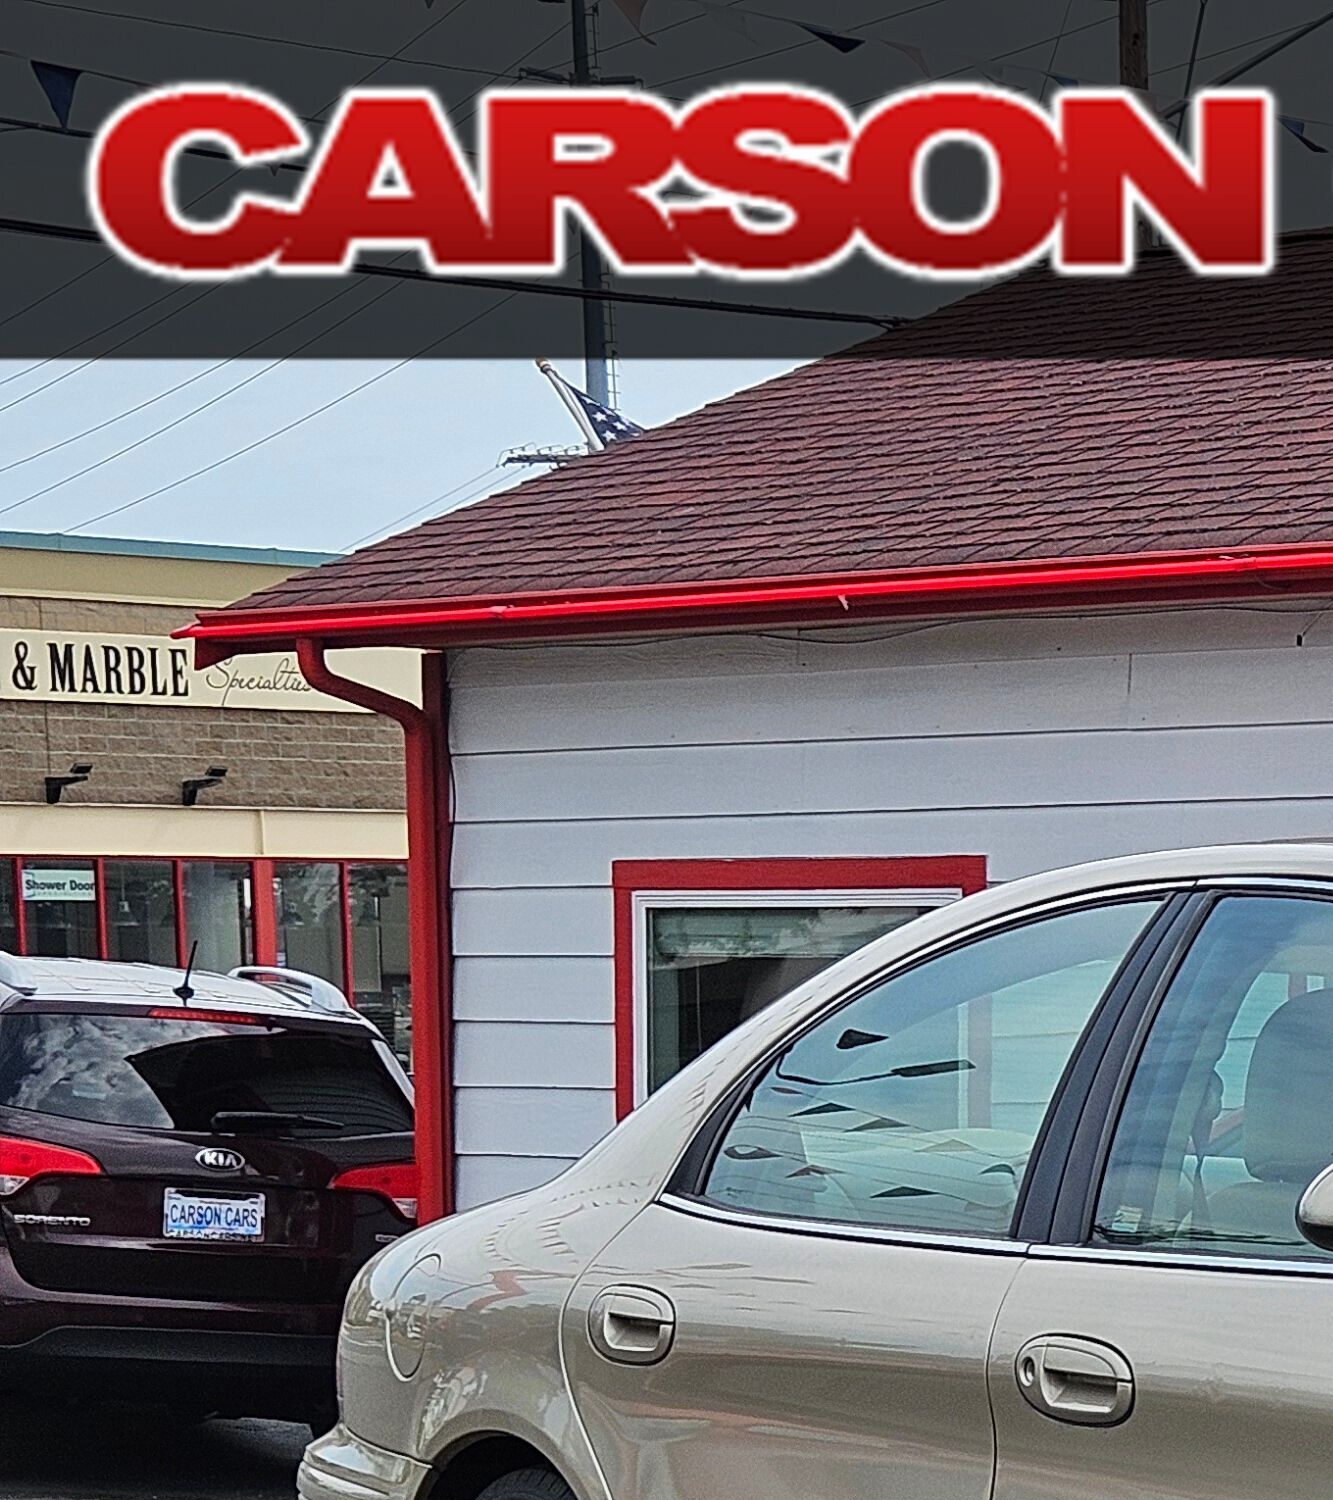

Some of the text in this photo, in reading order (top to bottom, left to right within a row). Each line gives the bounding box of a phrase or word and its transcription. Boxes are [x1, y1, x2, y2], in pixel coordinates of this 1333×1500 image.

[12, 640, 38, 691] &
[46, 642, 189, 697] MARBLE
[25, 879, 95, 891] Shower Door
[203, 1151, 238, 1168] KIA
[13, 1214, 91, 1227] SORENTO
[170, 1203, 258, 1228] CARSON CARS
